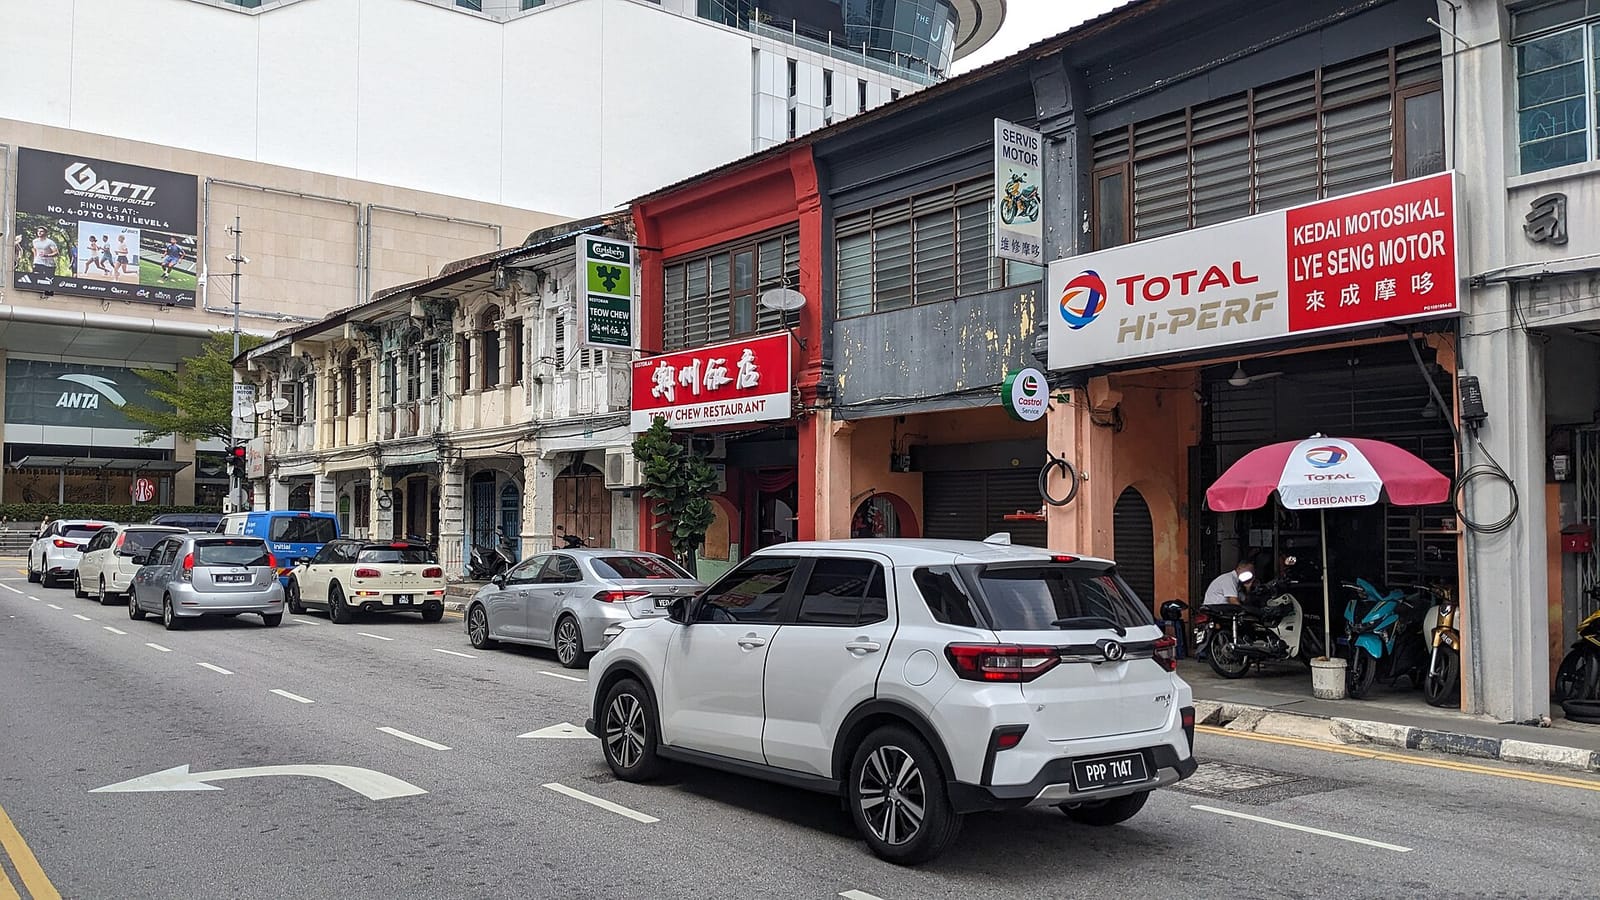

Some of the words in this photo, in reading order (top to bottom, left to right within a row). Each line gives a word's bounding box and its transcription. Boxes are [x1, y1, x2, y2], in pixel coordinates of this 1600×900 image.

[917, 12, 930, 25] THE
[1002, 128, 1038, 151] SERVIS
[1002, 144, 1039, 167] MOTOR
[64, 162, 157, 200] GATTI
[64, 189, 94, 199] SPORTS
[94, 192, 128, 203] FACTORY
[127, 198, 156, 207] OUTLET
[80, 201, 103, 211] FIND
[106, 205, 119, 213] US
[47, 205, 65, 215] NO.
[67, 208, 90, 218] 4-07
[91, 211, 104, 219] TO
[106, 214, 125, 223] 4-13
[133, 217, 161, 228] LEVEL
[1293, 219, 1341, 246] KEDAI
[1345, 197, 1445, 232] MOTOSIKAL
[592, 242, 624, 259] Carlsberg
[1293, 253, 1323, 283] LYE
[1327, 244, 1374, 271] SENG
[1379, 230, 1446, 268] MOTOR
[1116, 261, 1259, 306] TOTAL
[590, 307, 609, 318] TEOW
[610, 311, 630, 321] CHEW
[1116, 290, 1279, 344] Hi-PERF
[56, 392, 99, 409] ANTA
[675, 405, 702, 420] CHEW
[703, 400, 767, 418] RESTAURANT
[1018, 397, 1043, 407] Castrol
[1021, 407, 1040, 416] Service
[1303, 472, 1355, 482] TOTAL
[1297, 494, 1367, 506] LUBRICANTS
[1085, 763, 1107, 782] PPP
[1110, 759, 1133, 778] 7147
